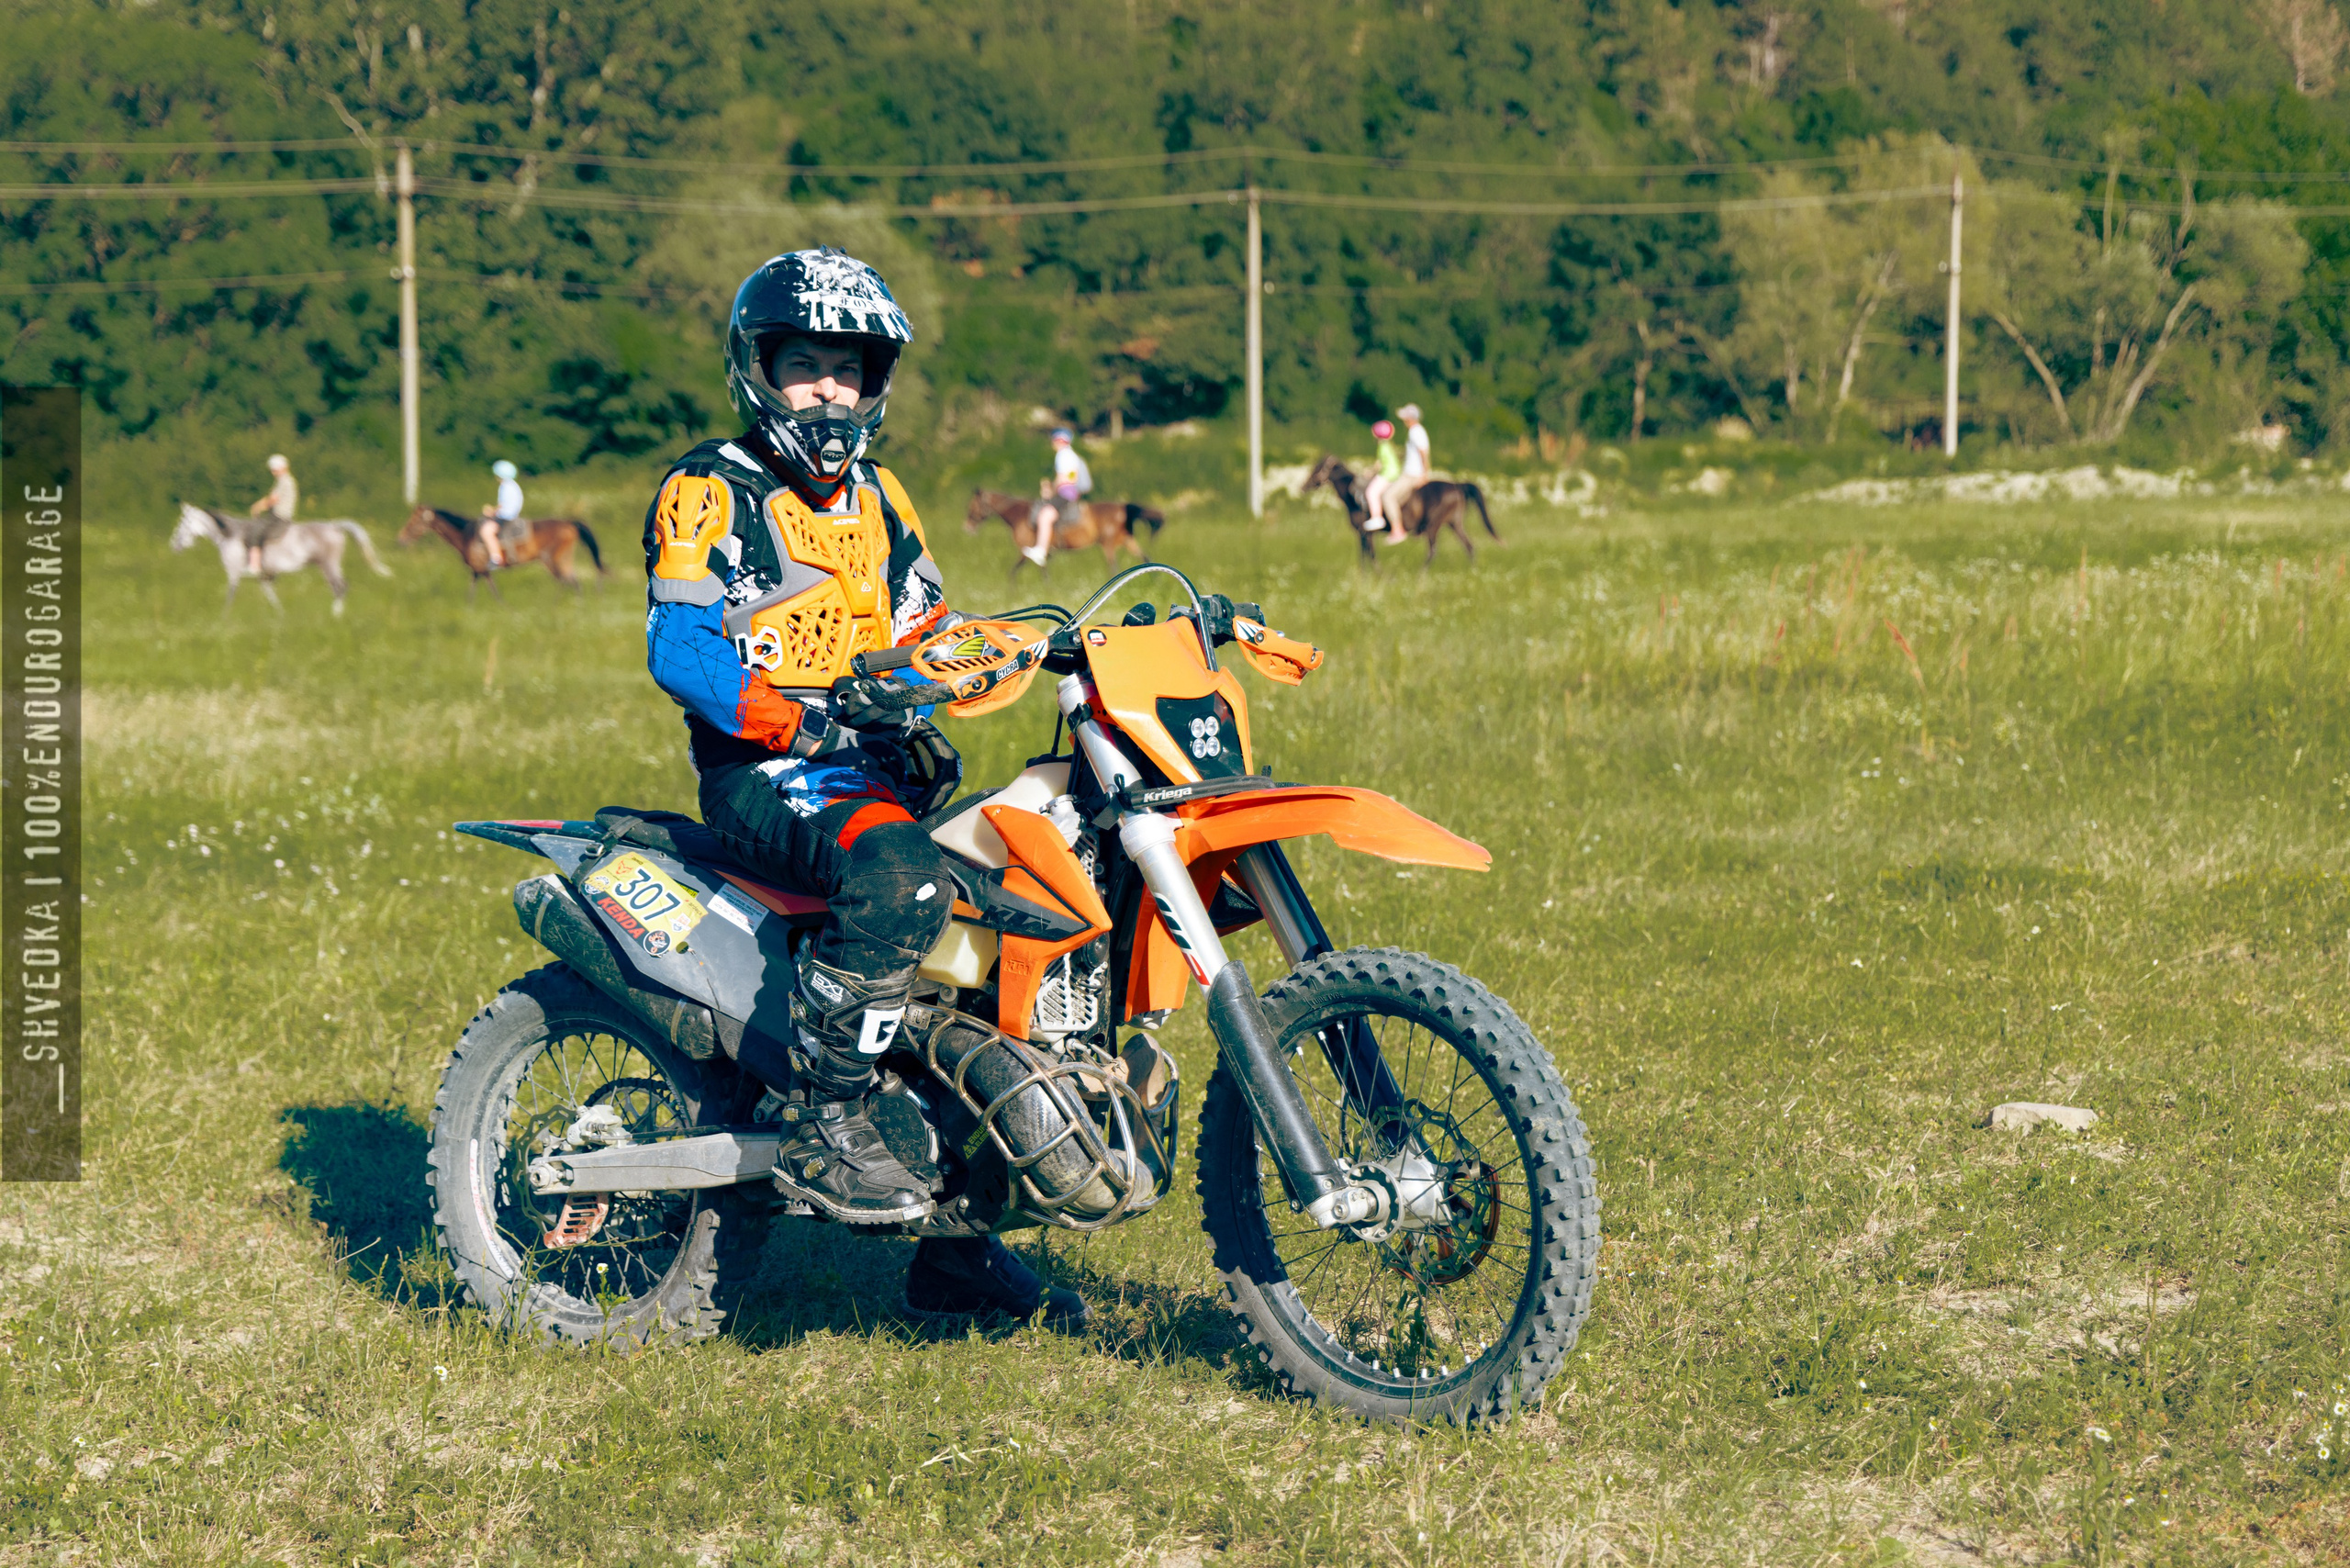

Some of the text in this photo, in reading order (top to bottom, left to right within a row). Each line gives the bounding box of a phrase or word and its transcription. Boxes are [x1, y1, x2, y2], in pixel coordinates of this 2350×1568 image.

[996, 659, 1020, 680] CYCRA
[1143, 787, 1193, 803] Kriega
[614, 868, 682, 922] 307
[597, 896, 646, 939] KENDA
[980, 903, 1054, 935] KTM
[1003, 958, 1030, 976] KTM
